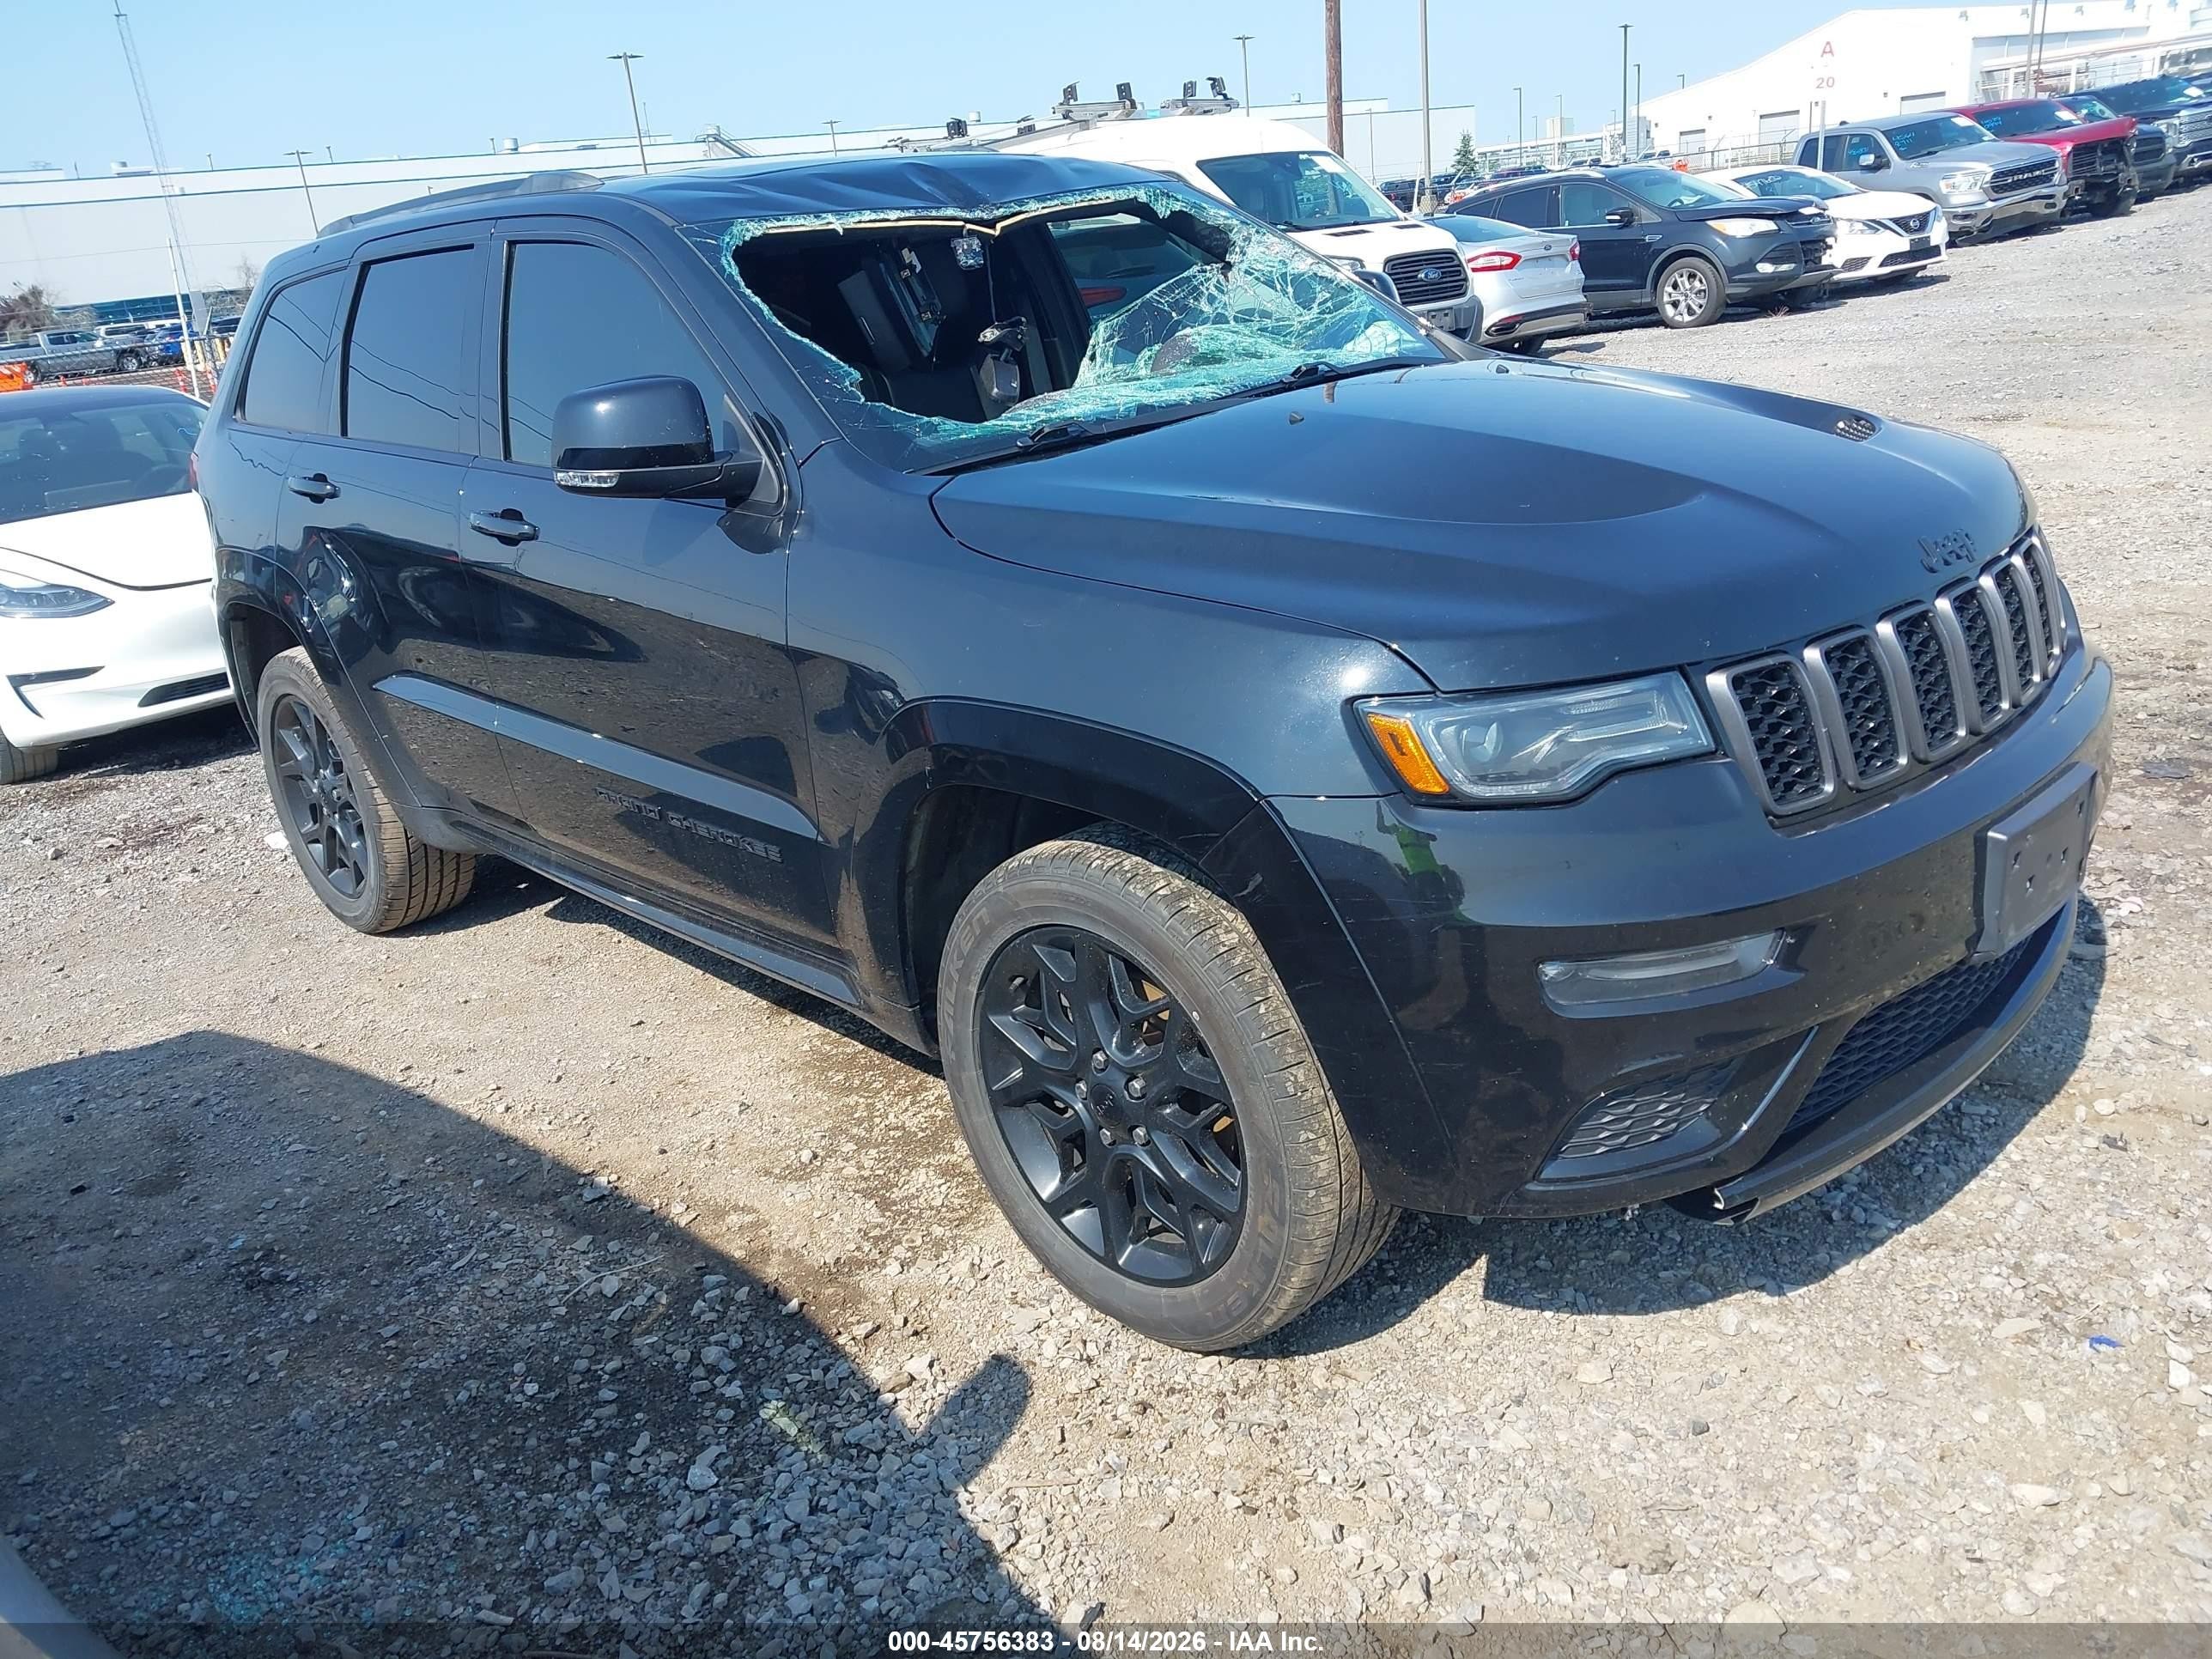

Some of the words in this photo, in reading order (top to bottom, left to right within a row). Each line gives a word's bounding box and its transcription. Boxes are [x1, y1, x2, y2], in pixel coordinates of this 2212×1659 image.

[1820, 40, 1835, 58] A
[1815, 76, 1835, 89] 20
[2013, 169, 2045, 181] RAM
[1917, 528, 1977, 574] Jeep
